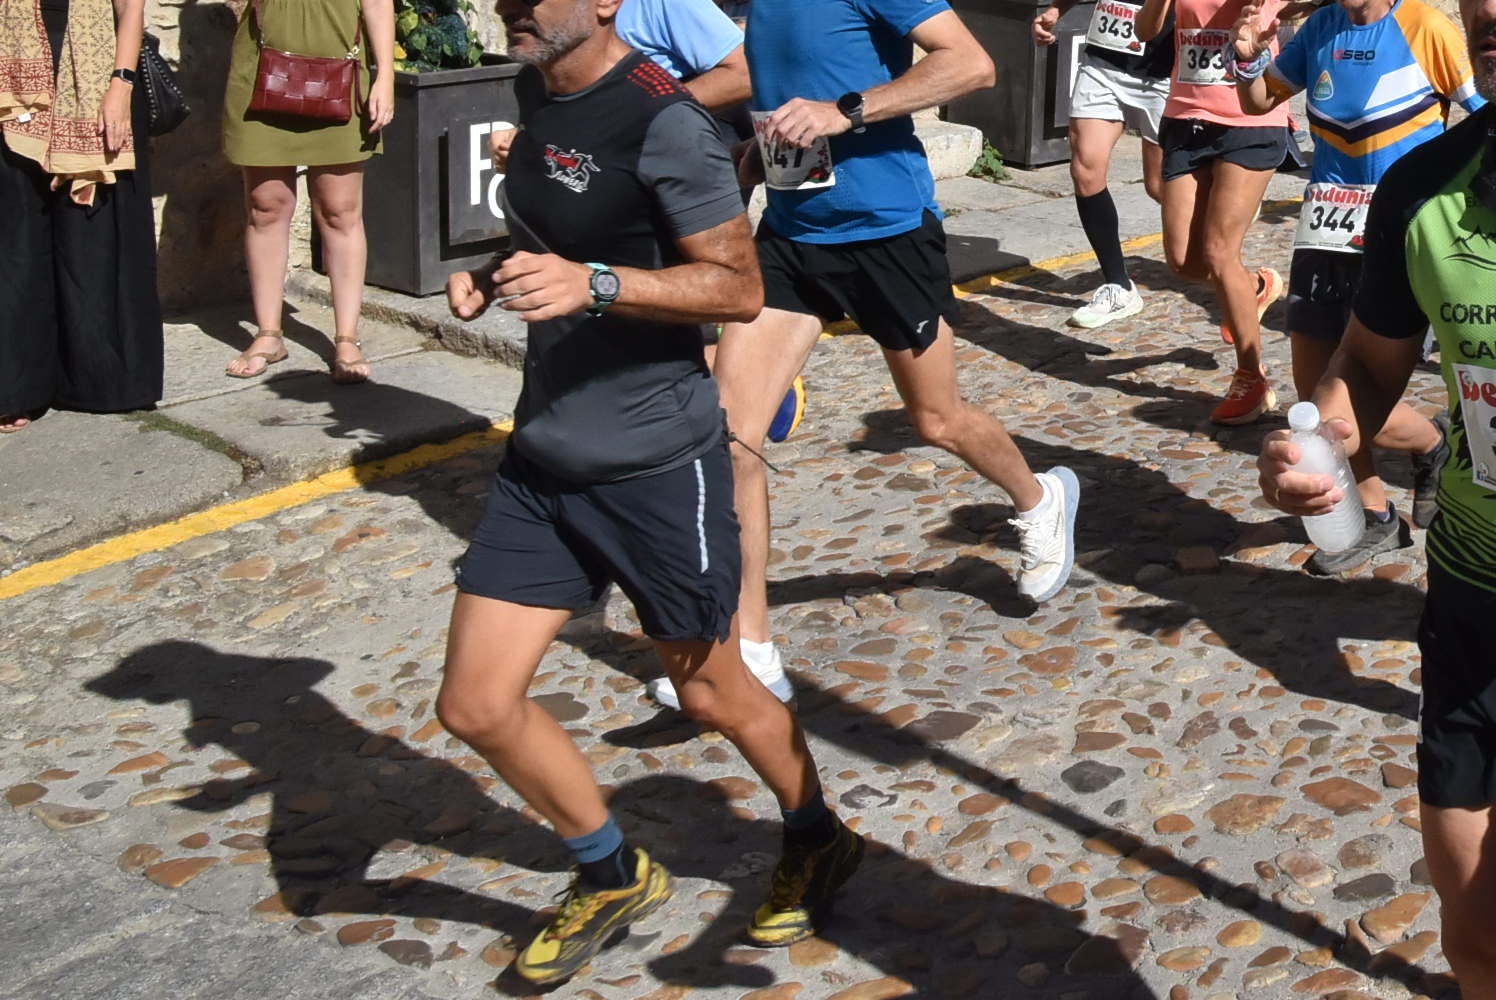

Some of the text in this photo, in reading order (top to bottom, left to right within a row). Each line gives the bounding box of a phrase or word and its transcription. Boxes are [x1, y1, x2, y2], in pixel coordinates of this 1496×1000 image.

[1098, 16, 1133, 39] 343
[1187, 49, 1226, 70] 363
[1309, 205, 1356, 233] 344
